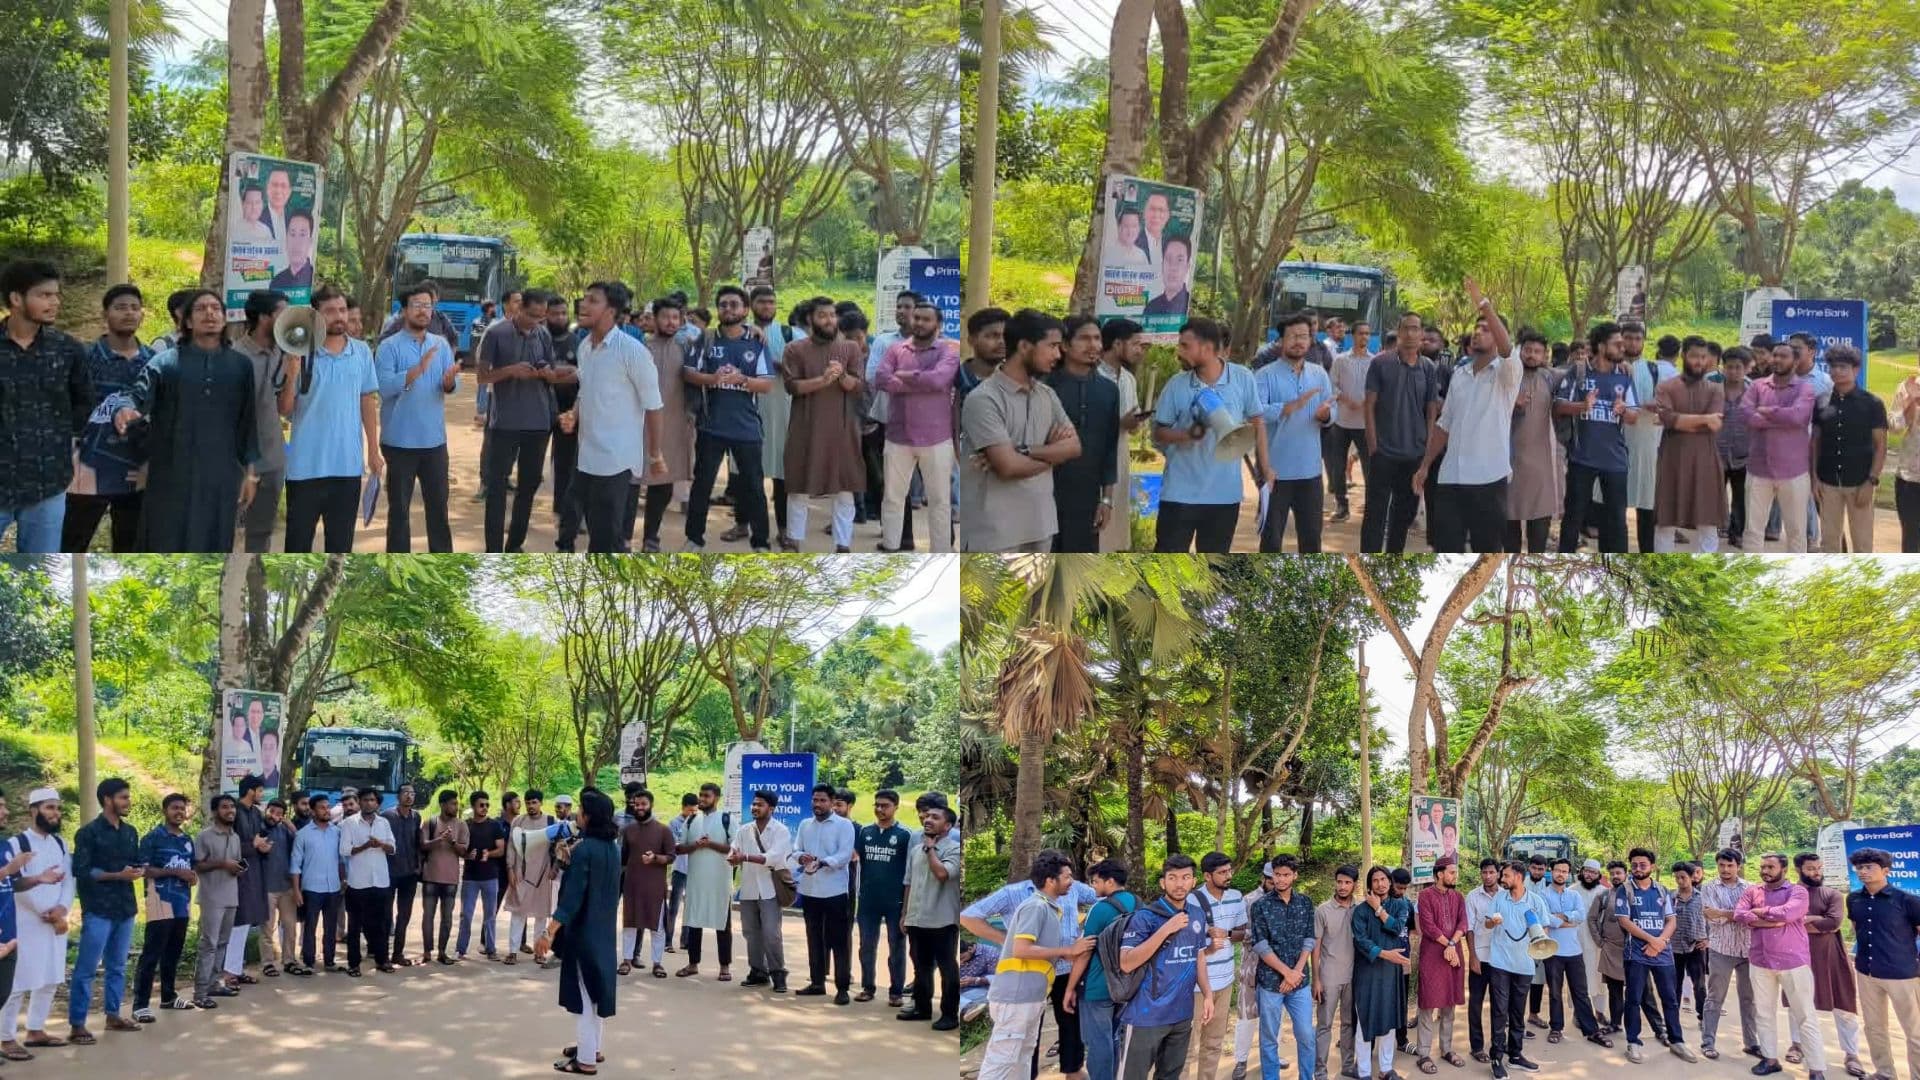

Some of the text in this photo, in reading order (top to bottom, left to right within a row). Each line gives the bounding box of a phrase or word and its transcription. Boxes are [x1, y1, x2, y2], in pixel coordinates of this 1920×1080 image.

[943, 295, 960, 306] TO
[1797, 308, 1850, 318] Prime Bank
[761, 760, 803, 768] Prime Bank
[749, 783, 805, 792] FLY TO YOUR
[1864, 831, 1913, 841] Prime Bank
[1632, 918, 1665, 930] ENGLIS
[1173, 945, 1195, 959] ICT
